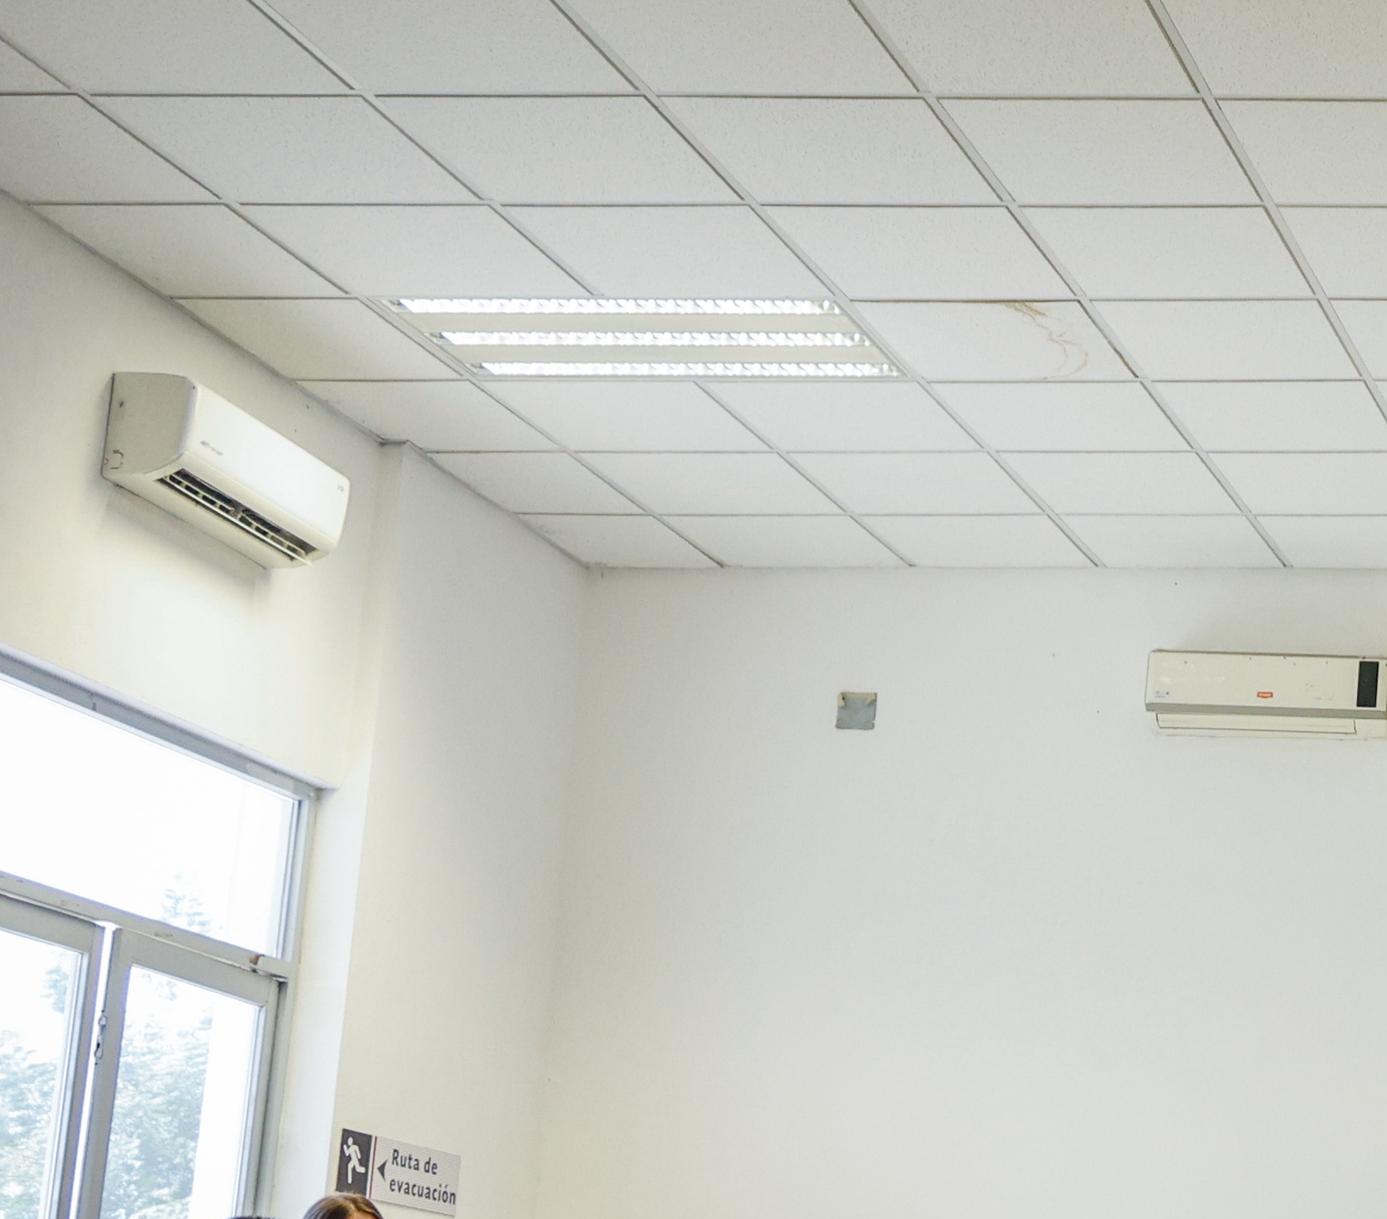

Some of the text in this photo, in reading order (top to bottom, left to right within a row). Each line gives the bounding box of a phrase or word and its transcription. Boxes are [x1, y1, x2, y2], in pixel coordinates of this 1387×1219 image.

[390, 1148, 439, 1176] Ruta de
[389, 1177, 457, 1206] evacuación
